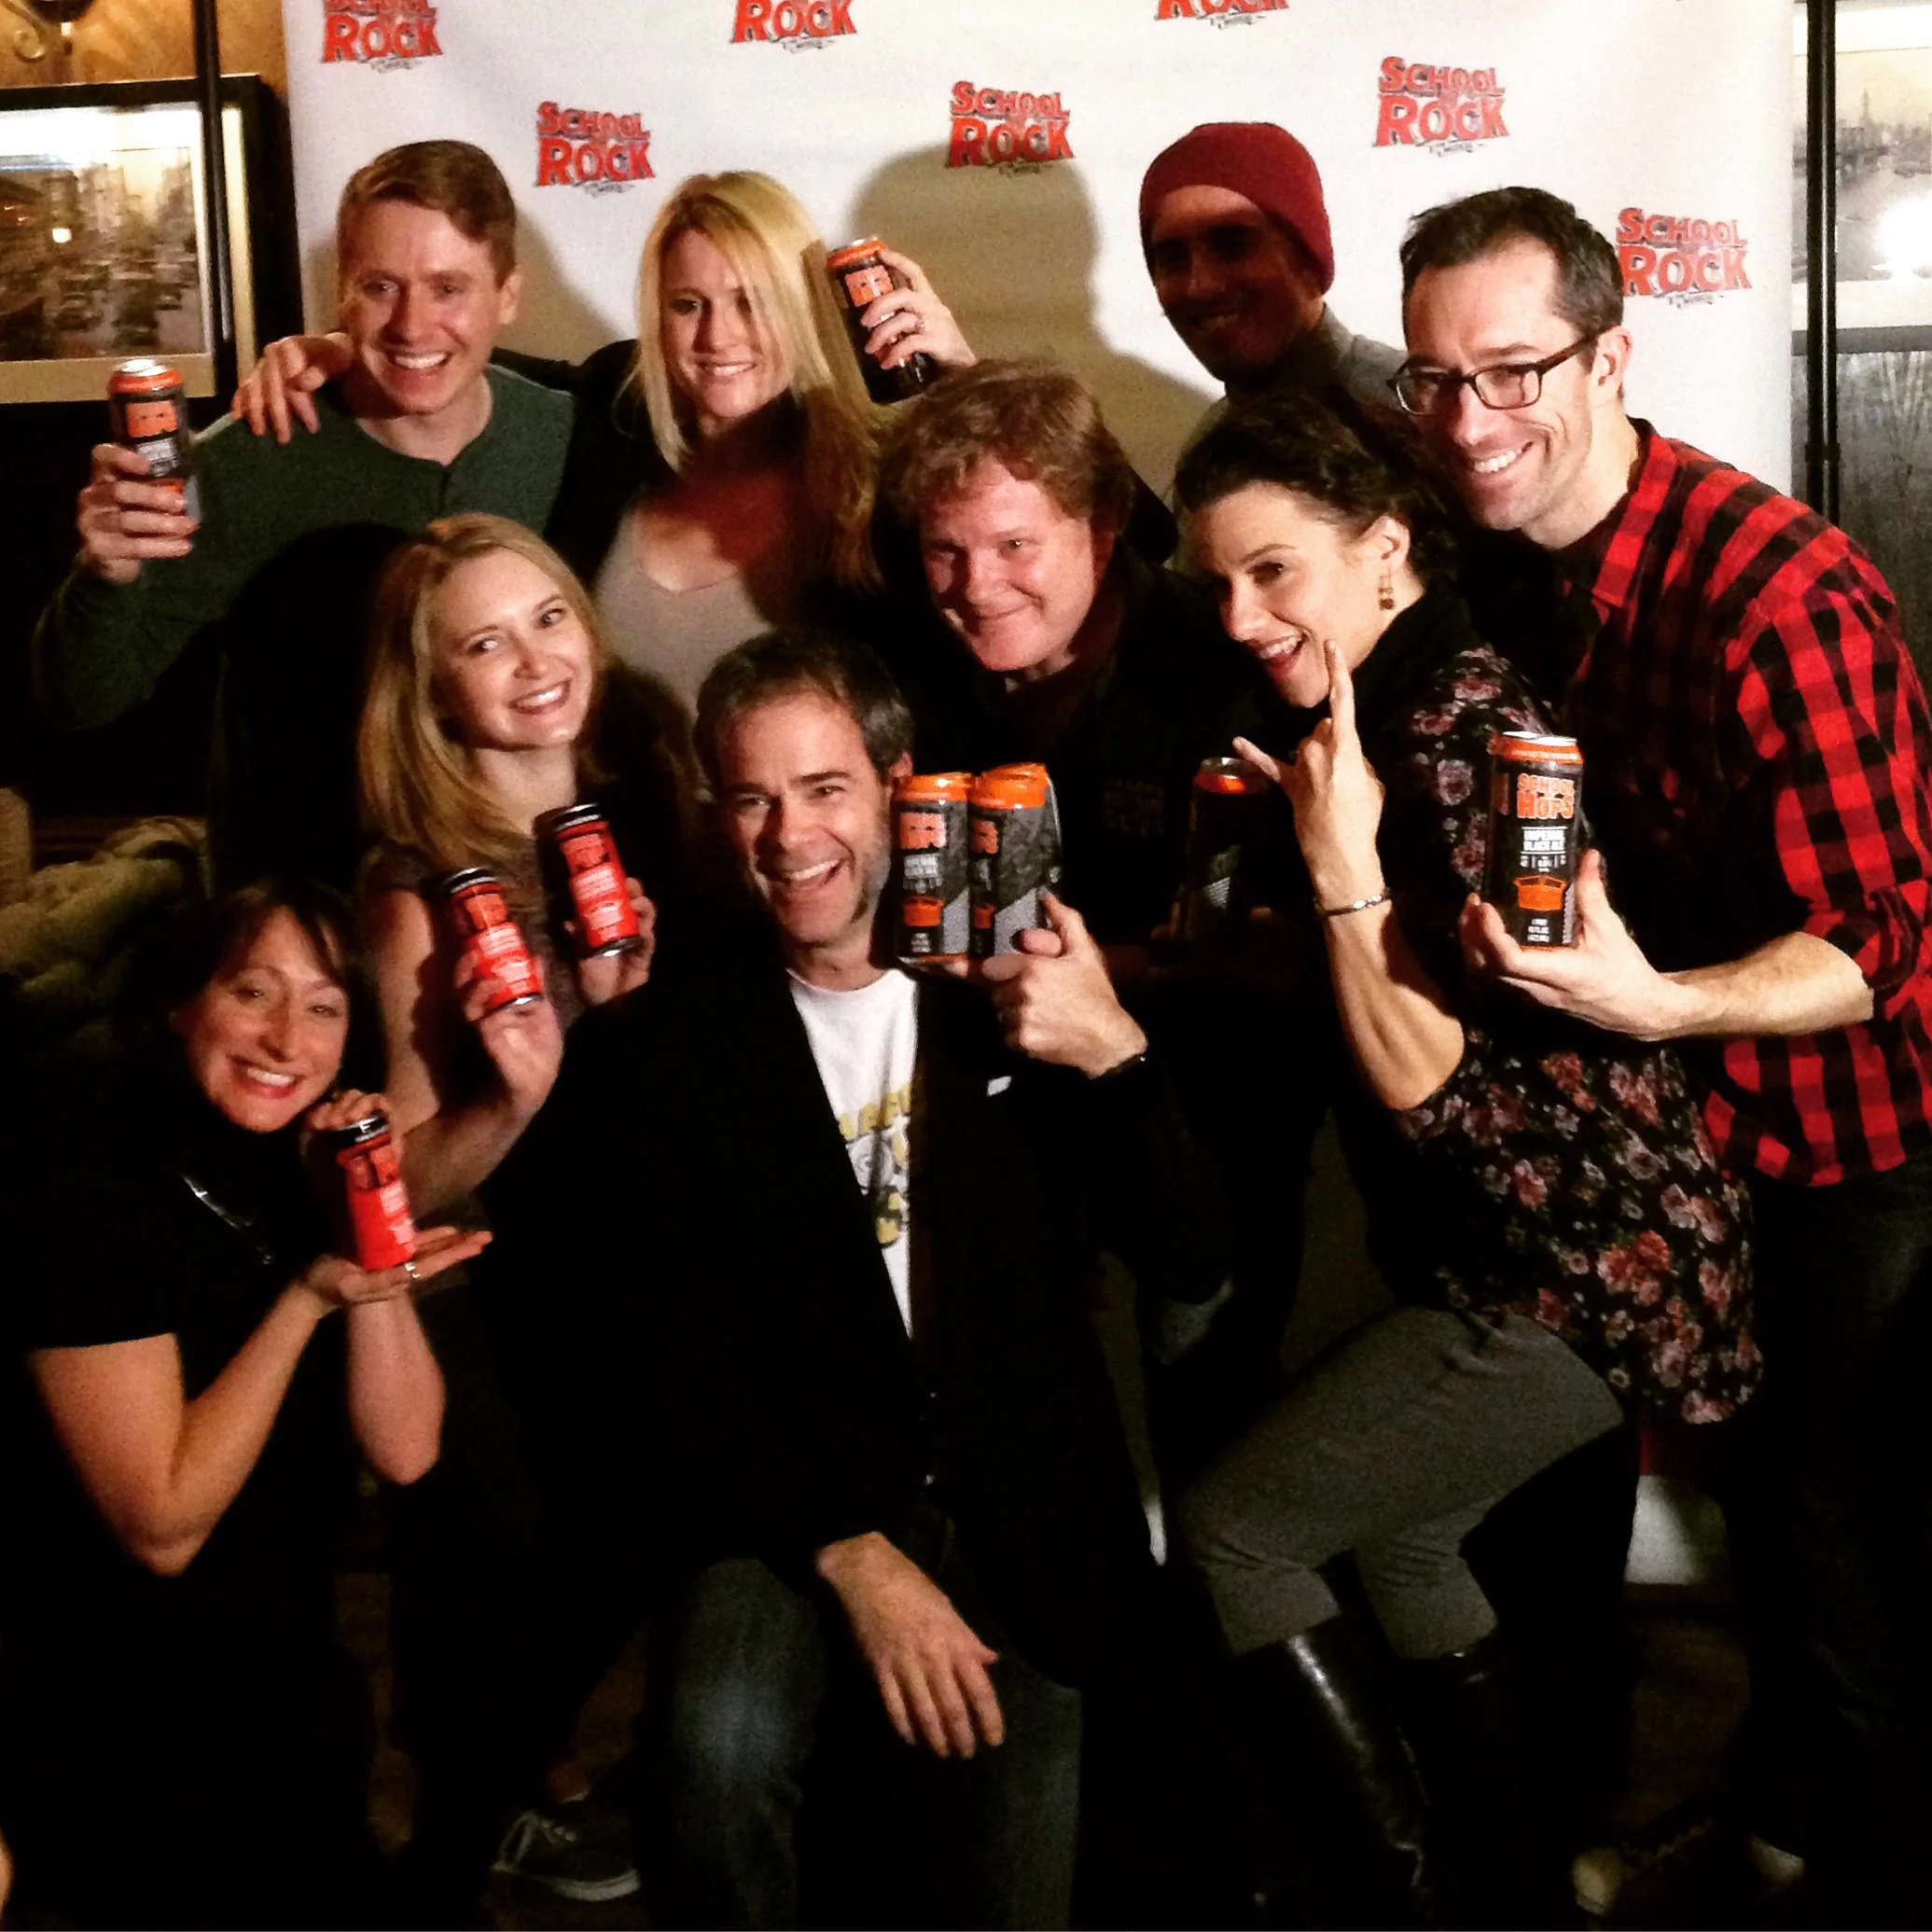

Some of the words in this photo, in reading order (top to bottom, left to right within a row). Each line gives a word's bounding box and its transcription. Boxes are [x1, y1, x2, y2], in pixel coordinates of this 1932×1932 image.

[321, 15, 443, 63] ROCK
[730, 0, 856, 44] ROCK
[1379, 56, 1506, 96] SCHOOL
[536, 102, 650, 139] SCHOOL
[951, 80, 1070, 118] SCHOOL
[1373, 95, 1510, 146] ROCK
[535, 138, 656, 186] ROCK
[946, 118, 1075, 168] ROCK
[1616, 207, 1747, 246] SCHOOL
[1619, 245, 1753, 298] ROCK
[1517, 791, 1575, 819] HOPS
